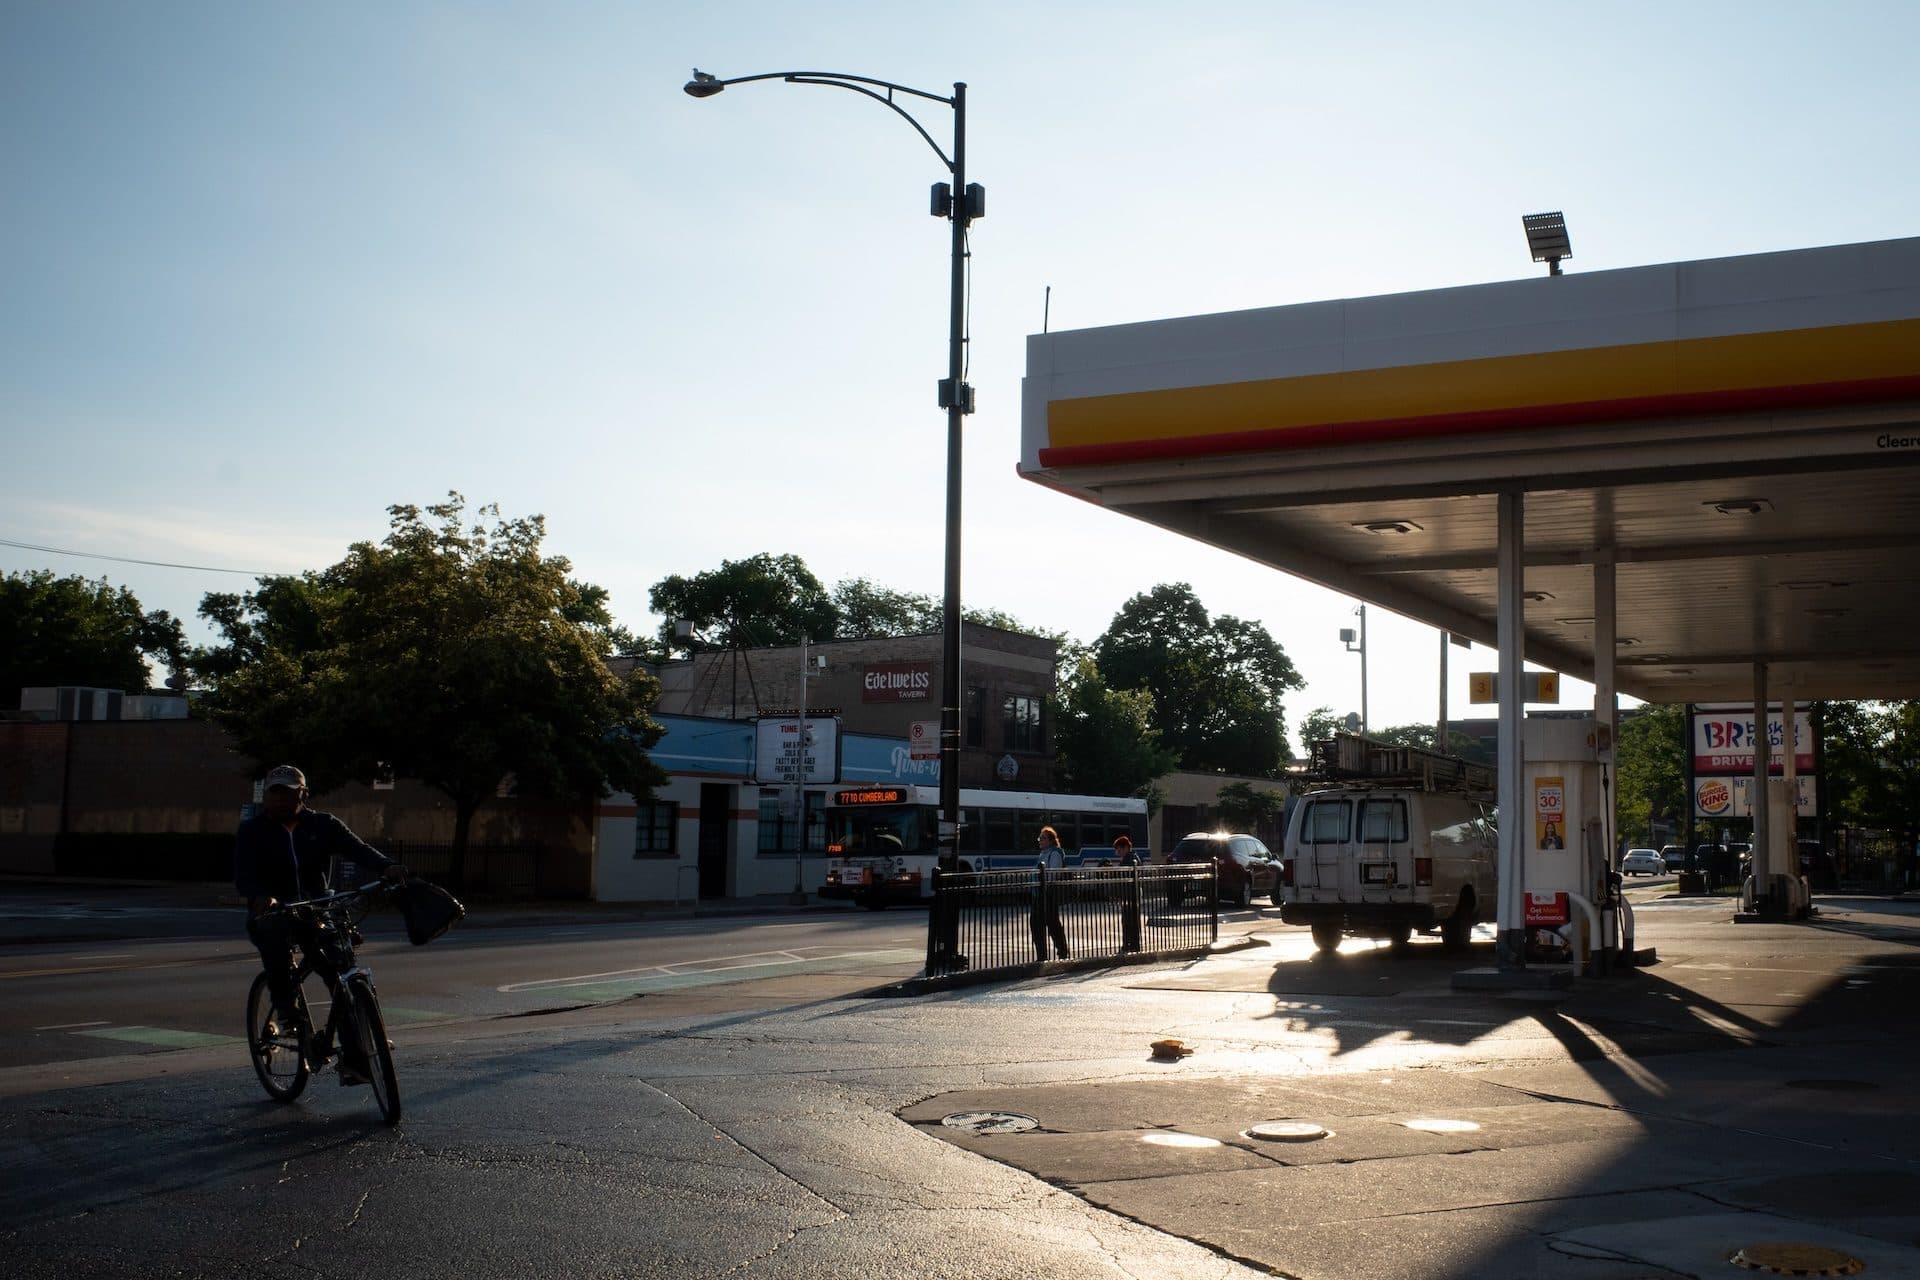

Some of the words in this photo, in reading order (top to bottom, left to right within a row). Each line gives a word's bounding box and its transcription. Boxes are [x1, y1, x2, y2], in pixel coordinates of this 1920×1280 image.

[864, 669, 929, 690] Edelweiss
[1478, 682, 1486, 694] 3
[1544, 681, 1553, 693] 4
[898, 690, 926, 699] TAVERN
[781, 725, 798, 733] TUNE
[1704, 721, 1744, 749] BR
[840, 792, 850, 803] 77
[859, 791, 898, 802] CUMBERLAND
[1700, 785, 1728, 800] BURGER
[1700, 792, 1729, 807] KING
